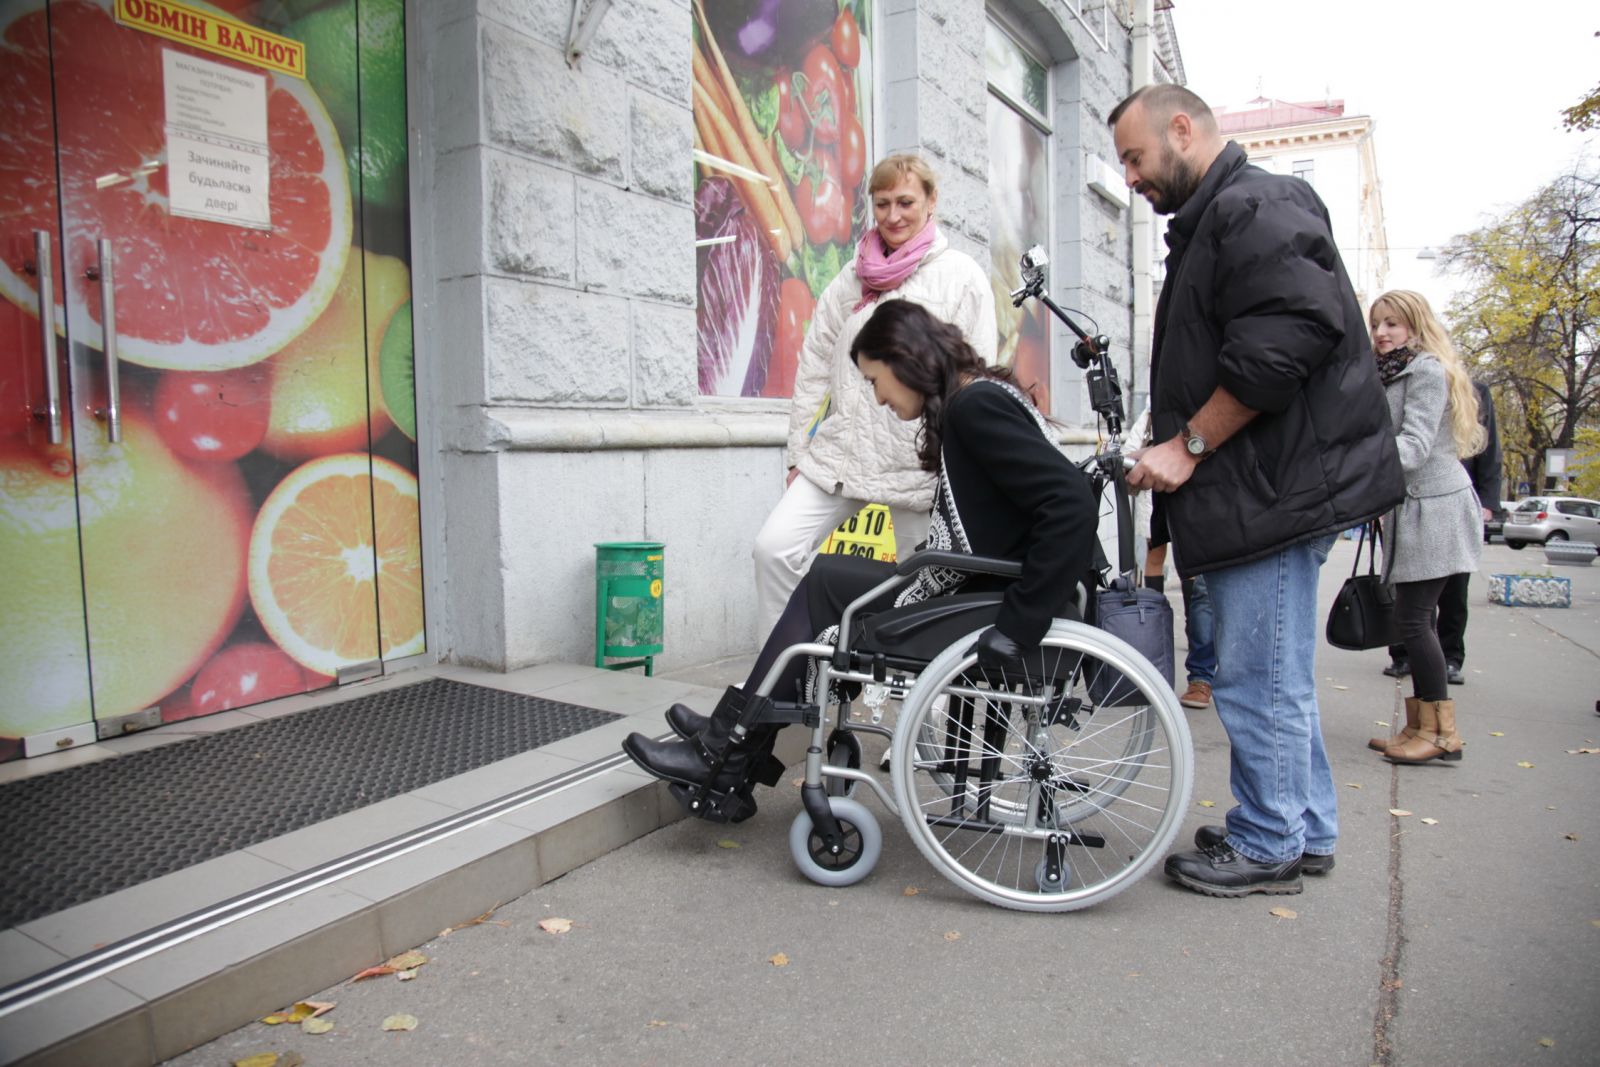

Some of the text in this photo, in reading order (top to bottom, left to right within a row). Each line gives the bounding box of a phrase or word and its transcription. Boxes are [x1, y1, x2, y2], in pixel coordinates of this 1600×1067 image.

[125, 0, 297, 68] ОБМІН ВАЛЮТ
[187, 150, 251, 175] Зачиняйте
